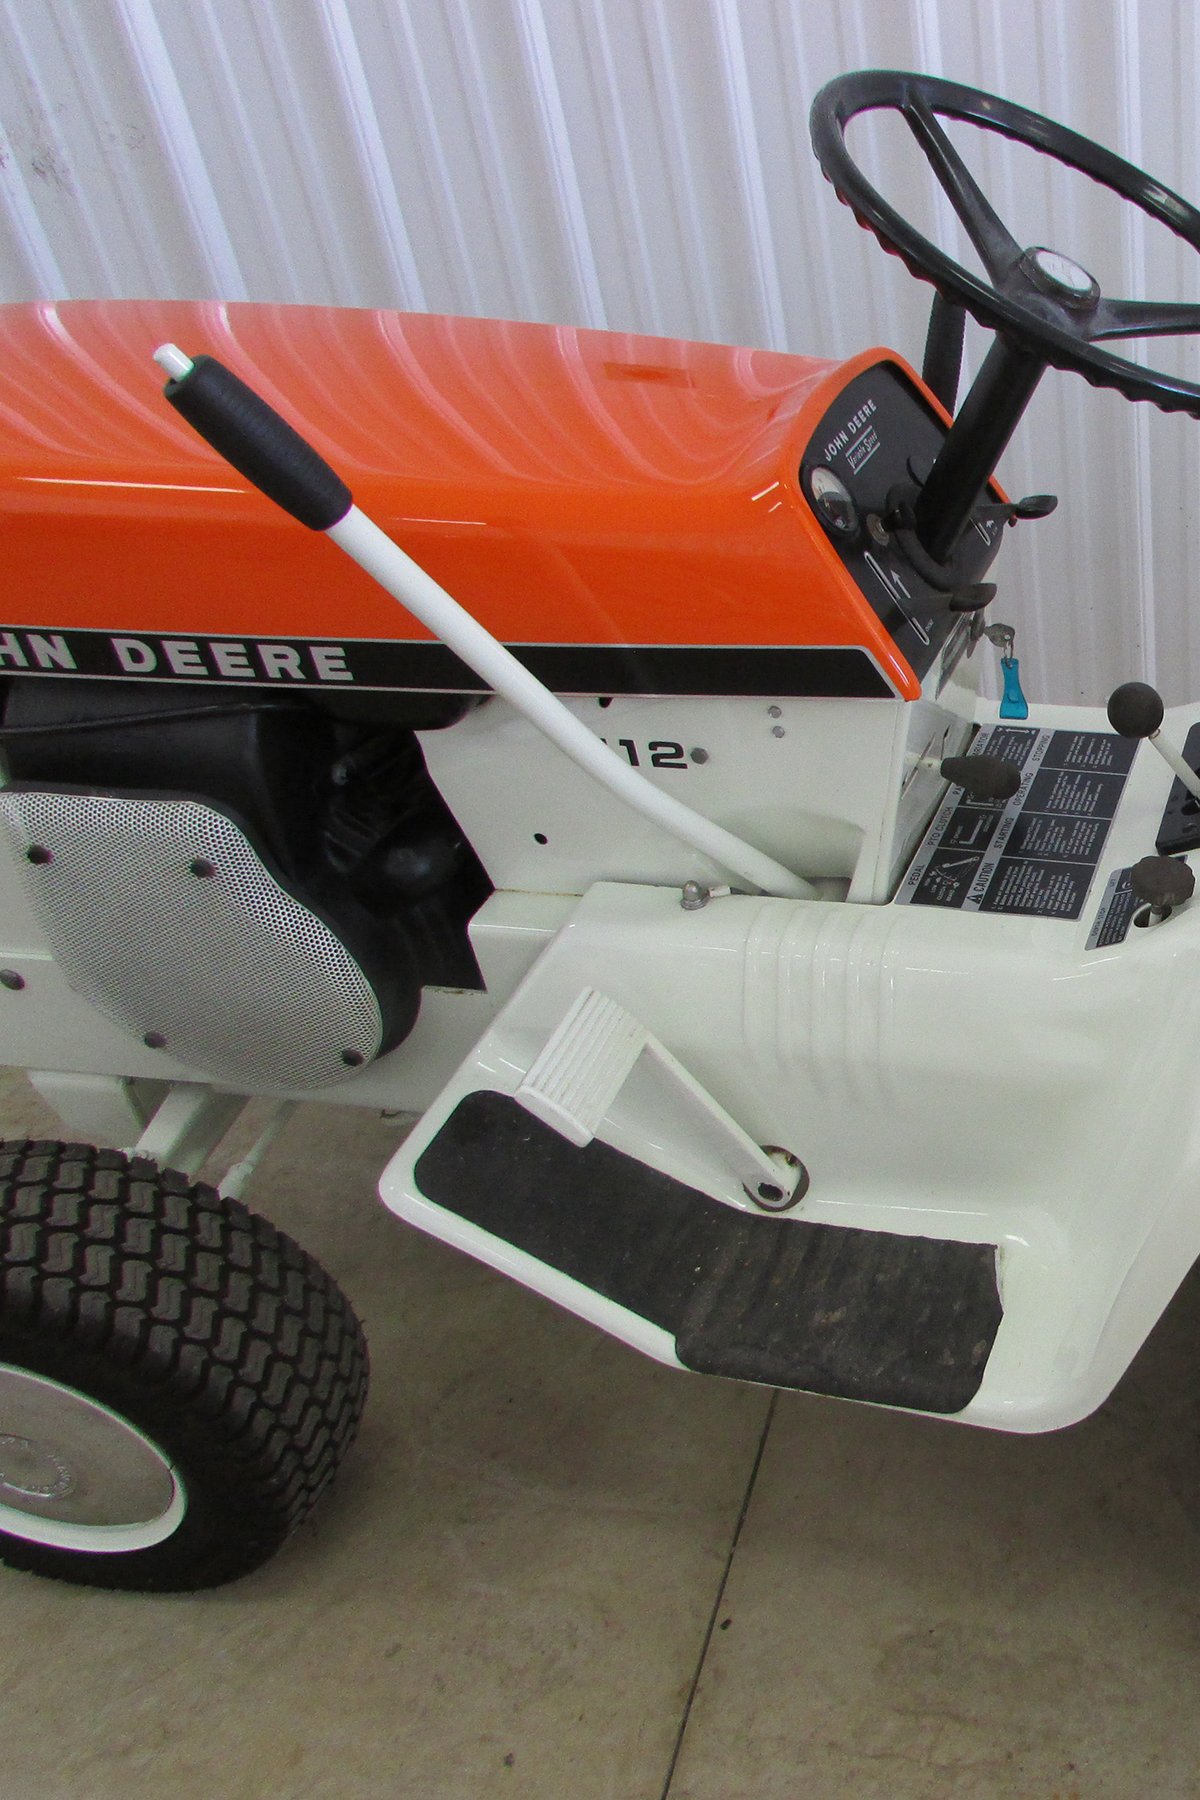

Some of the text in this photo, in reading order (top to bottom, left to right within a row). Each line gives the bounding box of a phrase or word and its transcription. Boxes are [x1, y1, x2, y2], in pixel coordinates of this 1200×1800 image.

[824, 399, 877, 462] JOHN DEERE
[110, 637, 354, 681] DEERE
[600, 737, 688, 769] 12
[1032, 734, 1050, 762] STOPPING
[1013, 772, 1034, 806] OPERATING
[928, 806, 954, 846] PTO CLUTCH
[994, 817, 1015, 849] STARTING
[908, 864, 925, 886] PEDAL
[973, 862, 995, 893] CAUTION
